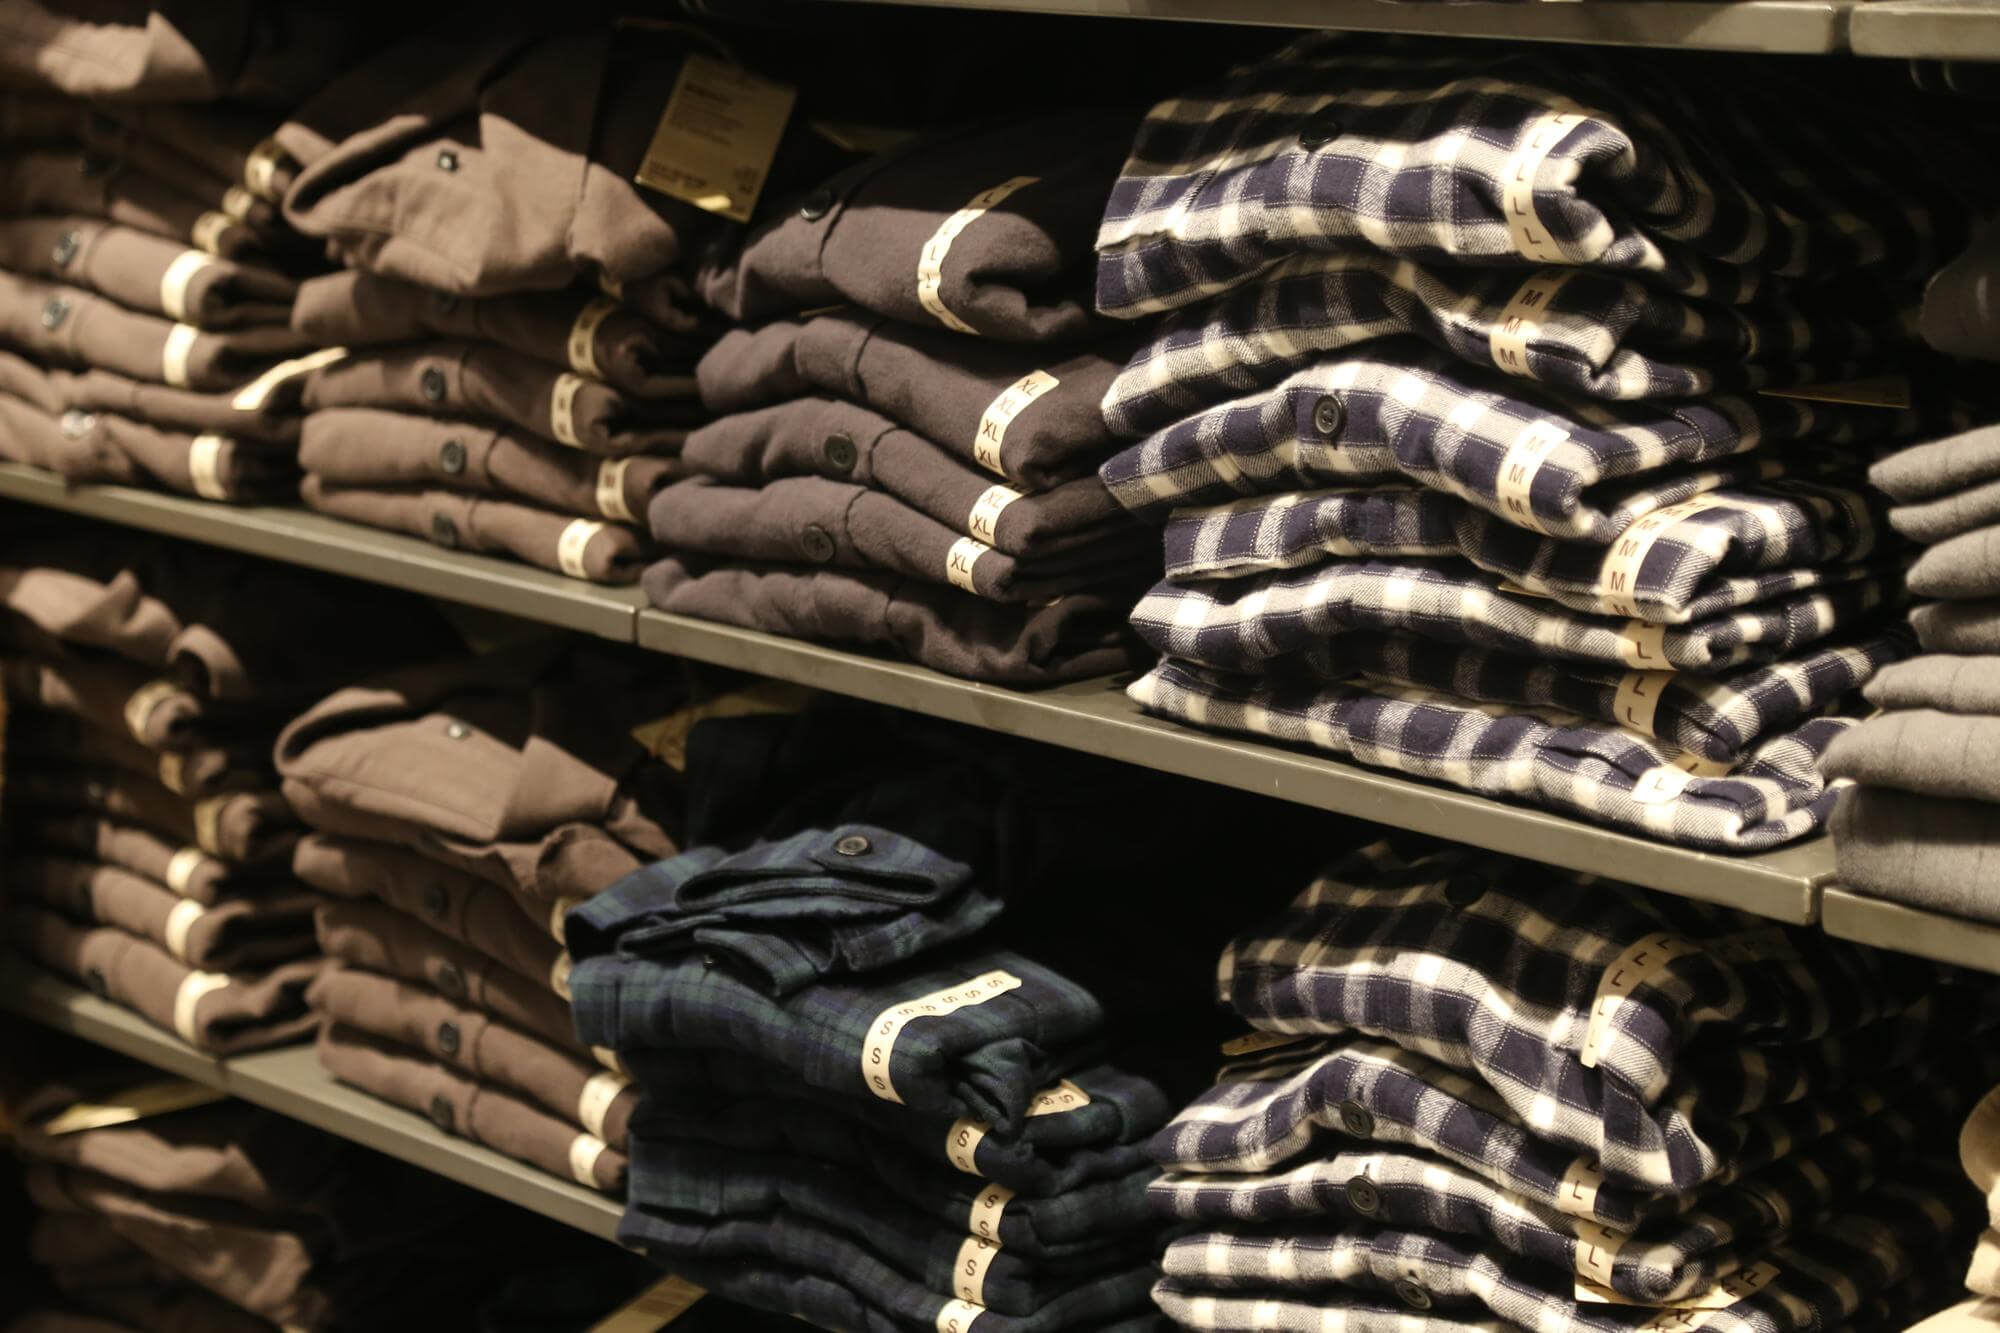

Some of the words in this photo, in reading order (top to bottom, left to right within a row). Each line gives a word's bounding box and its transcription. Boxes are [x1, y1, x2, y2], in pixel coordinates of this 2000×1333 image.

[1516, 163, 1524, 181] L
[1514, 196, 1526, 216] L
[1524, 226, 1541, 244] L
[1520, 289, 1543, 307] M
[1504, 315, 1521, 335] M
[1500, 347, 1518, 366] M
[1017, 378, 1038, 396] XL
[997, 396, 1016, 416] XL
[982, 419, 1000, 443] XL
[977, 445, 998, 468] XL
[1508, 464, 1526, 484] M
[1507, 495, 1525, 515] M
[973, 514, 991, 537] XL
[1619, 539, 1638, 557] M
[951, 552, 968, 574] XL
[1611, 571, 1626, 592] M
[1637, 641, 1652, 660] L
[1633, 676, 1645, 696] L
[1627, 706, 1640, 725] L
[1653, 776, 1665, 791] L
[1656, 938, 1670, 950] L
[1632, 951, 1648, 967] L
[987, 979, 1004, 988] S
[1611, 969, 1624, 987] L
[942, 995, 959, 1004] S
[965, 989, 981, 999] S
[880, 1020, 893, 1036] S
[871, 1047, 881, 1065] S
[873, 1075, 886, 1091] S
[957, 1130, 970, 1148] S
[1573, 1179, 1583, 1200] L
[984, 1194, 999, 1209] S
[979, 1220, 990, 1238] S
[1588, 1246, 1600, 1268] L
[965, 1259, 977, 1277] S
[947, 1318, 959, 1333] S
